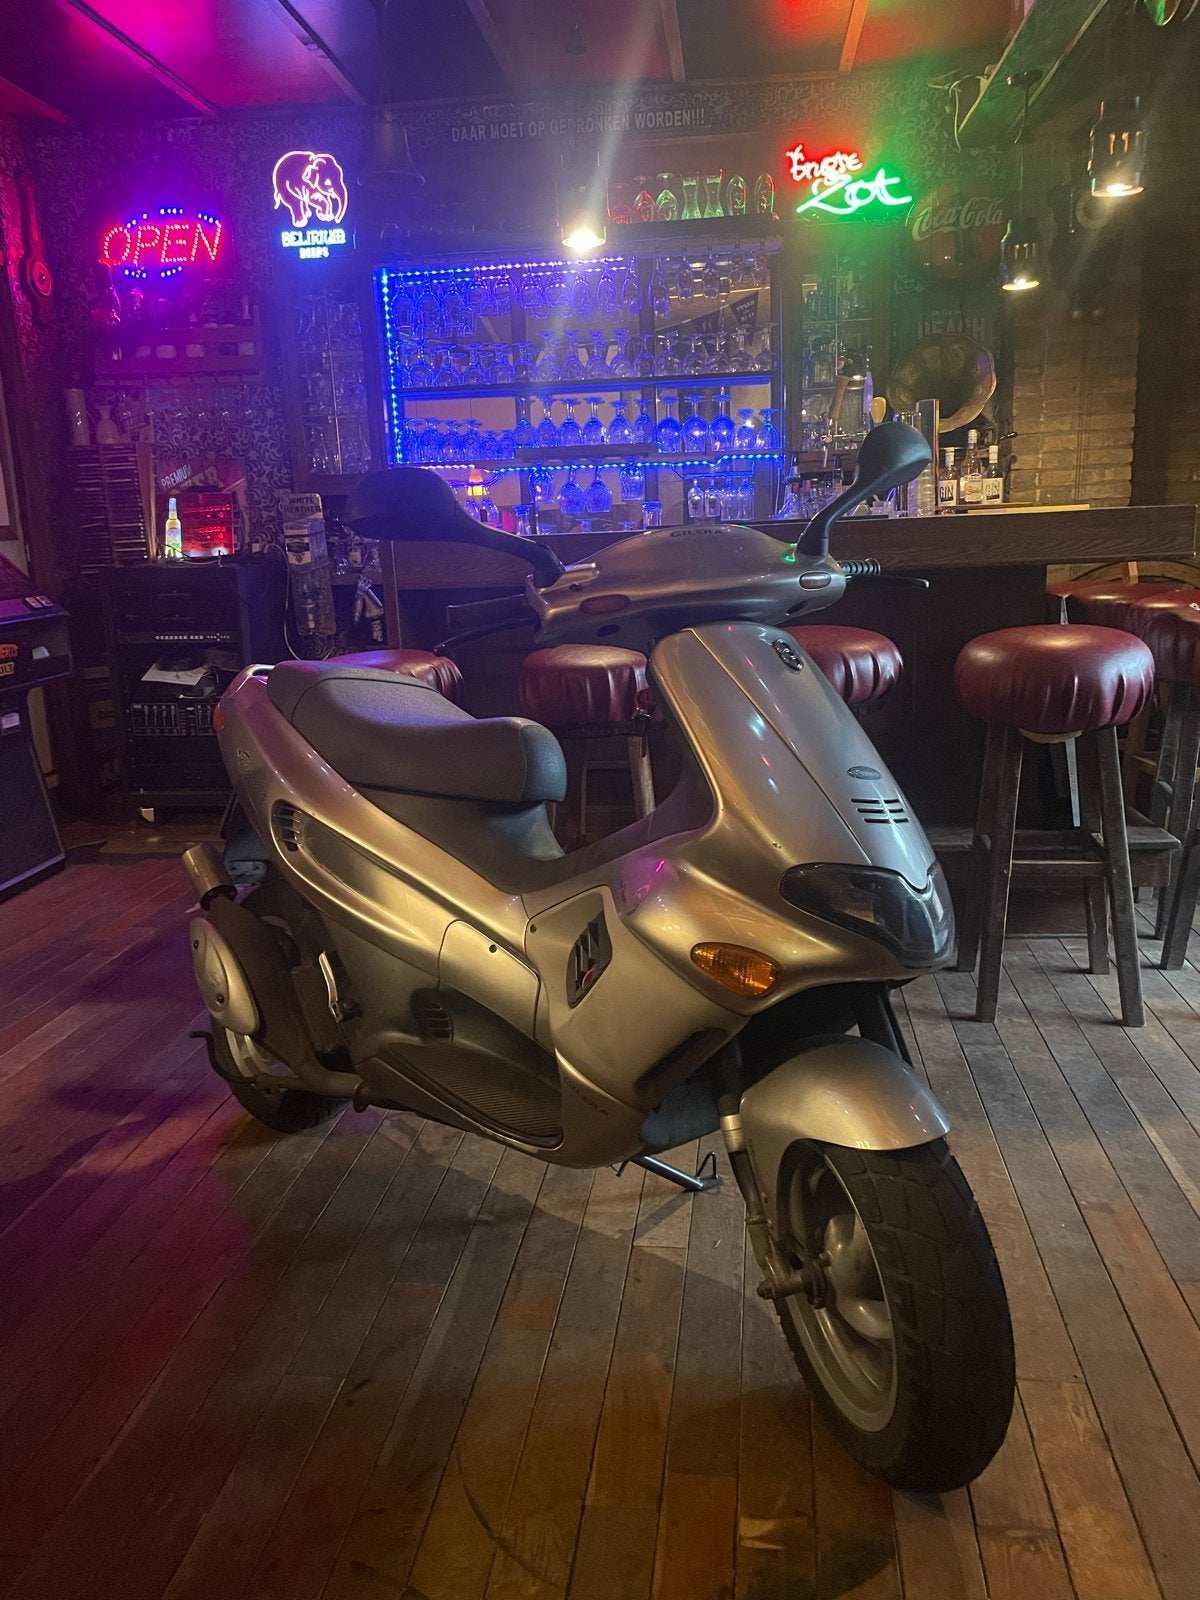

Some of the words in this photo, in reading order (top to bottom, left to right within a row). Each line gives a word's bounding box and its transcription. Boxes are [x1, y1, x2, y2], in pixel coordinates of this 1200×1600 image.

[451, 124, 487, 143] DAAR
[490, 121, 524, 140] MOET
[528, 118, 545, 137] OP
[635, 108, 705, 129] WORDEN!!!
[797, 168, 912, 215] Zot
[104, 221, 221, 267] OPEN
[160, 463, 193, 490] PREMIUM
[288, 496, 315, 505] WHITE
[670, 529, 724, 538] GILERA
